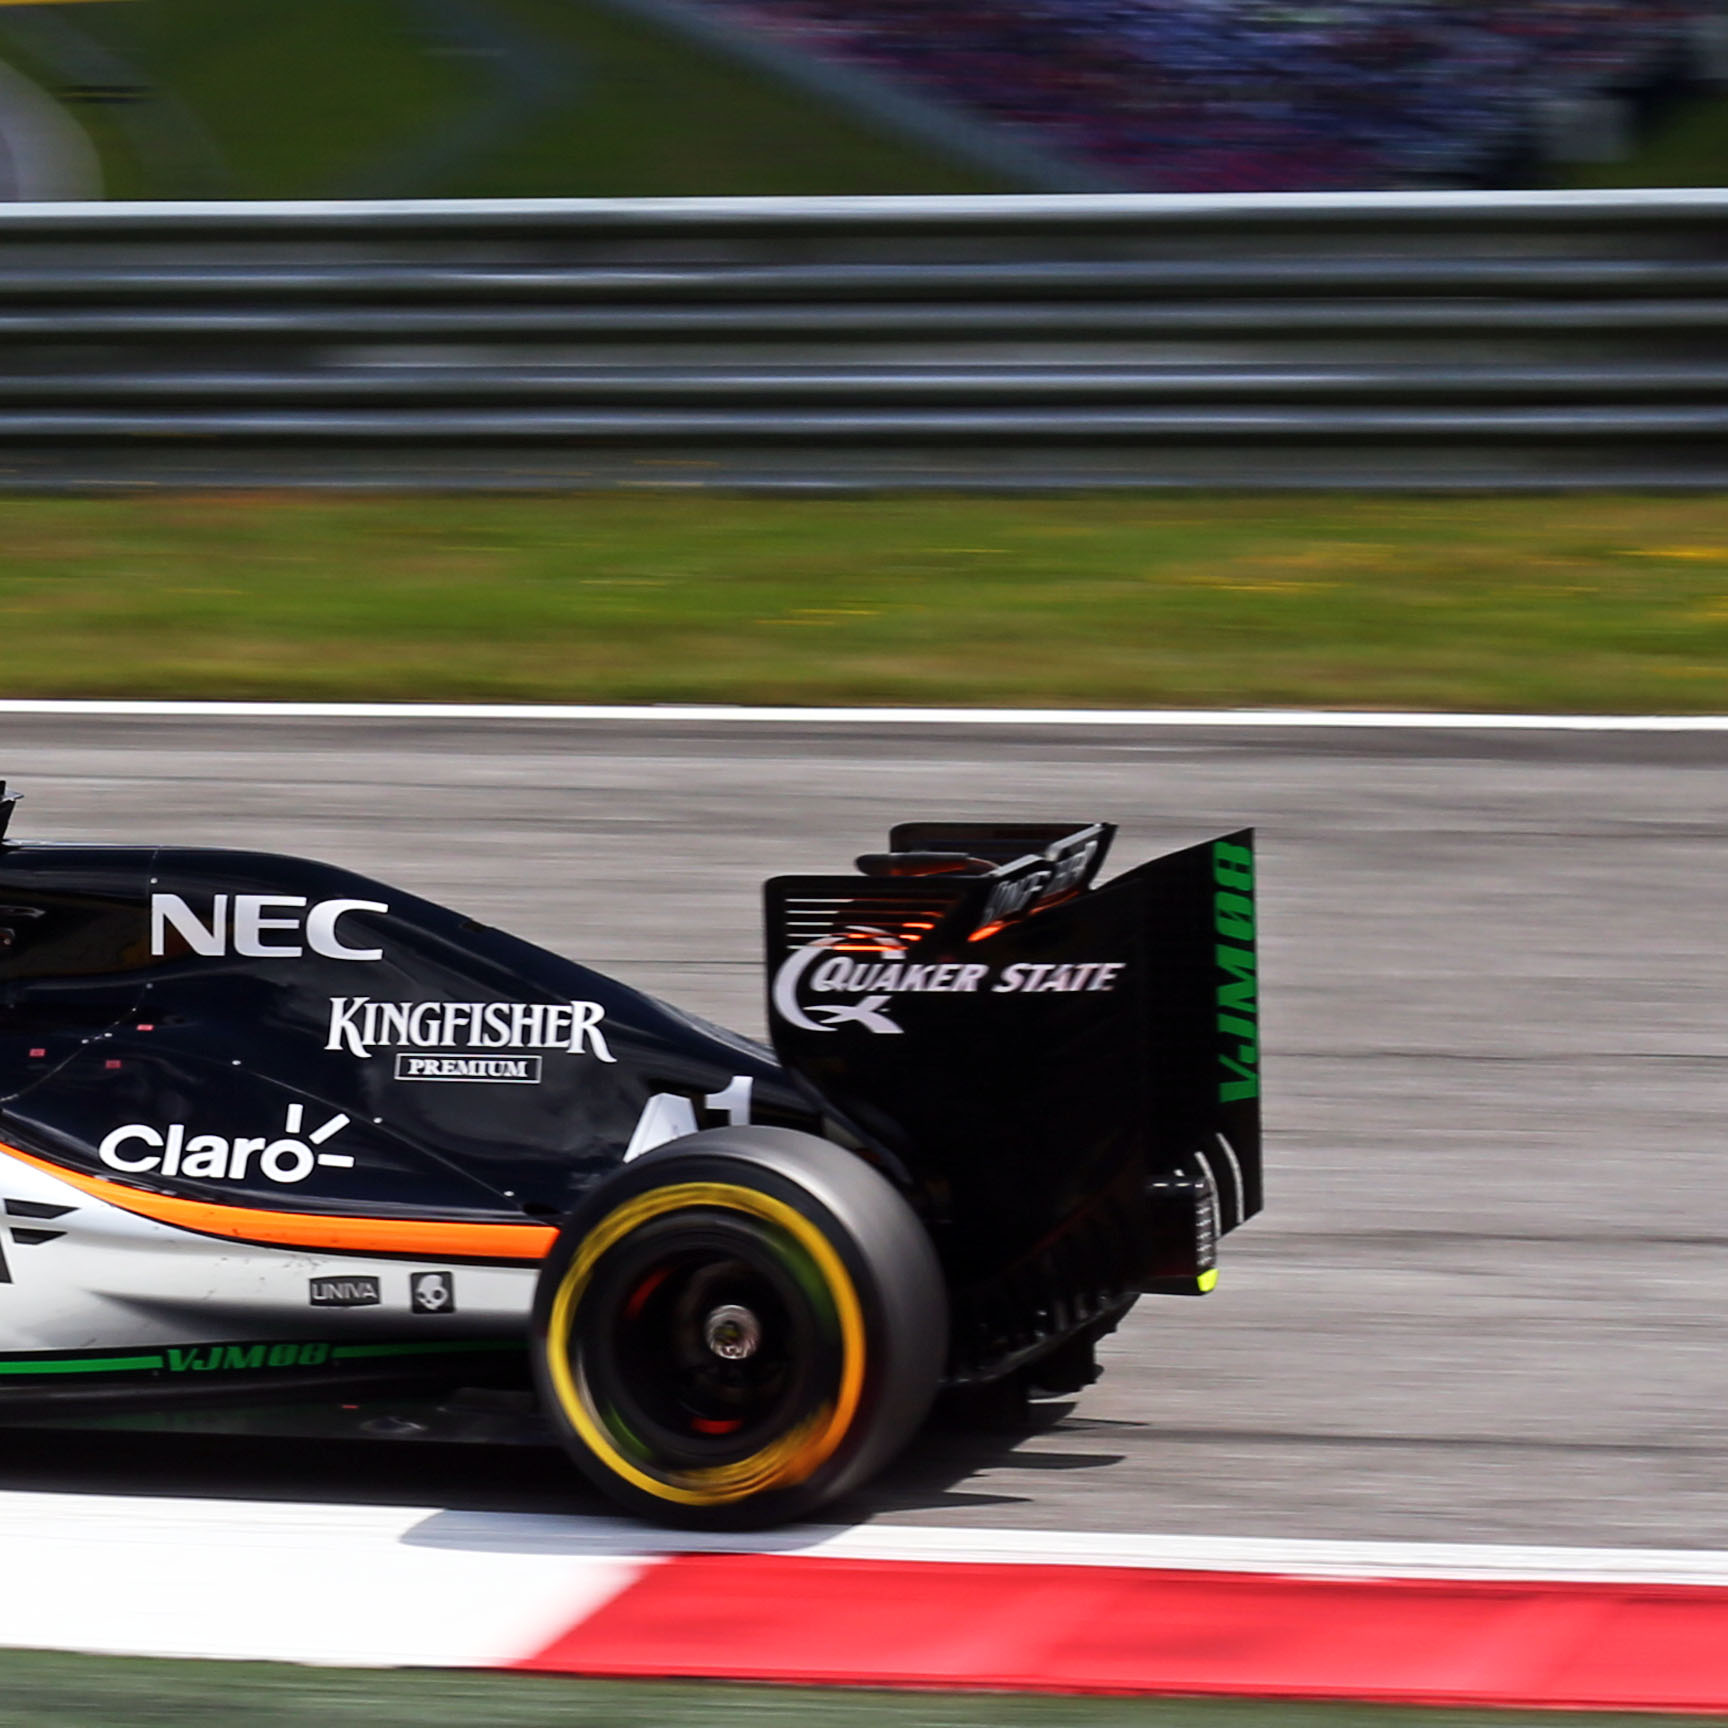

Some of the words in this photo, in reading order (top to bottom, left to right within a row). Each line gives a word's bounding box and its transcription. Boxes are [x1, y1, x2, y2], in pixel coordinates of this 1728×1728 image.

[151, 893, 389, 961] NEC
[810, 956, 989, 993] QUAKER
[992, 962, 1126, 993] STATE
[1213, 840, 1259, 1103] VJM08
[324, 996, 618, 1063] KINGFISHER
[408, 1058, 528, 1077] PREMIUM
[98, 1122, 316, 1183] Claro
[312, 1281, 378, 1301] UNIVA
[166, 1342, 331, 1372] VJM08
